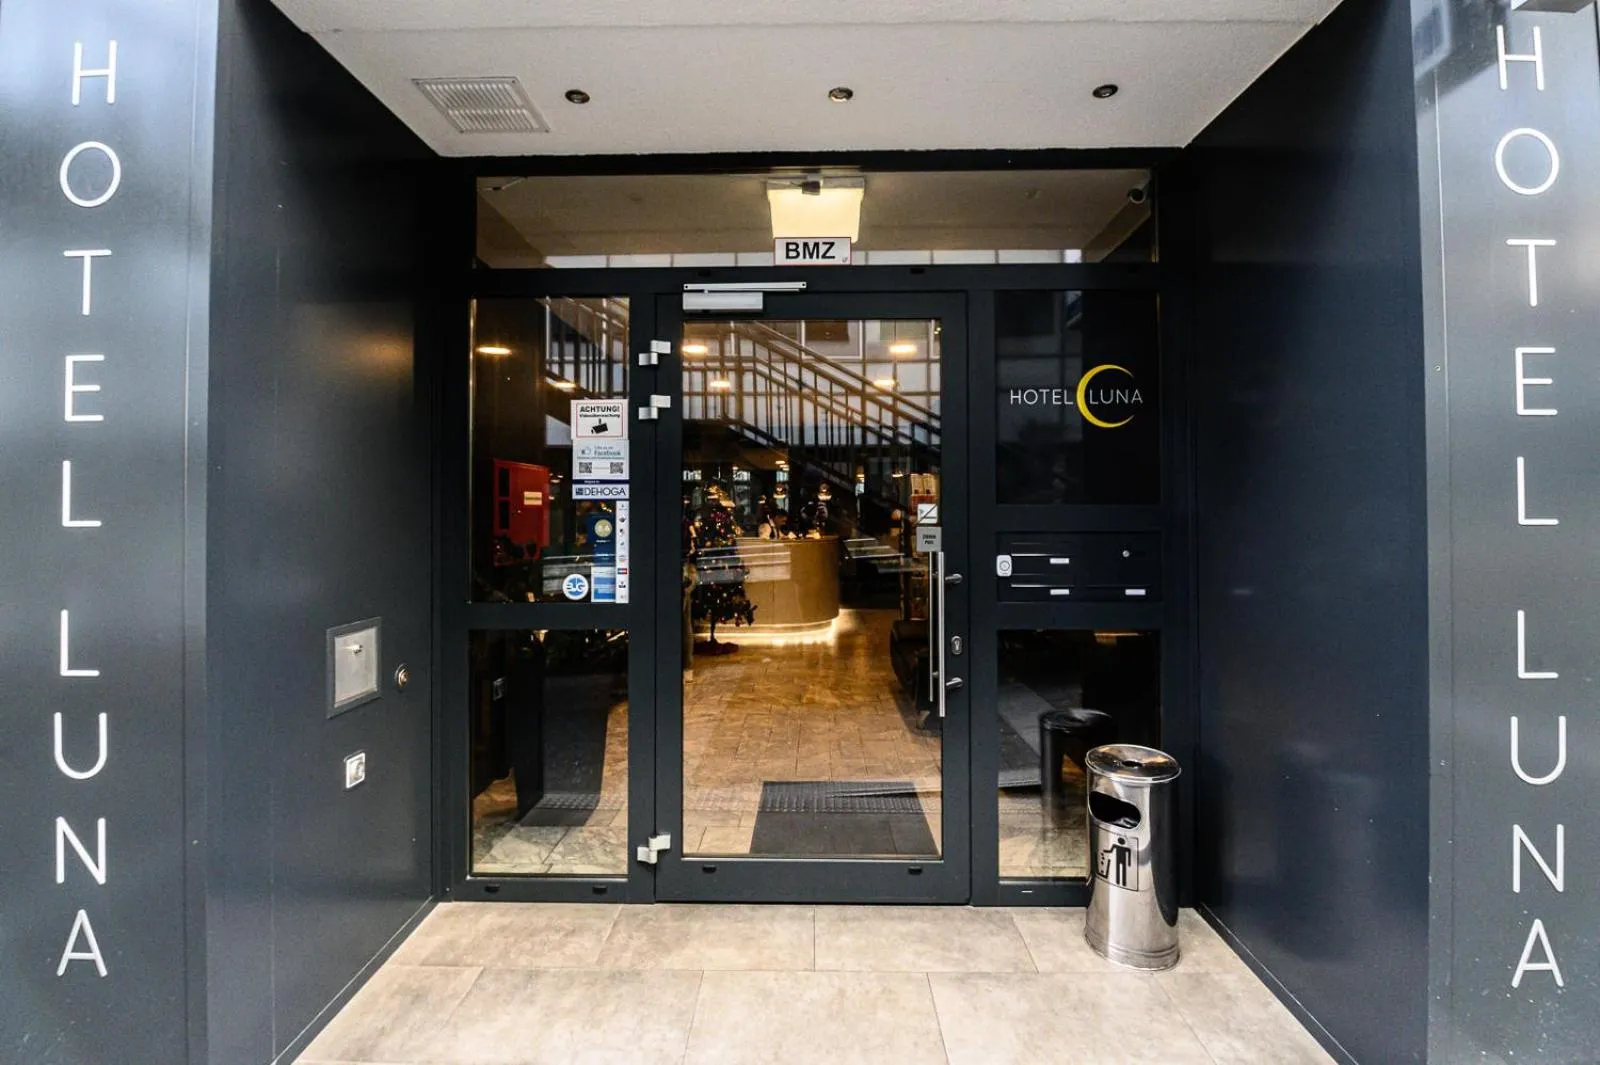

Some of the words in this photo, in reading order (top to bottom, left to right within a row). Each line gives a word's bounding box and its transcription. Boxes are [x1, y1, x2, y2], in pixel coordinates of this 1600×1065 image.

[59, 40, 121, 528] HOTEL
[785, 241, 836, 260] BMZ
[1495, 25, 1560, 526] HOTEL
[580, 405, 620, 413] ACHTUNG!
[584, 487, 626, 496] DEHOGA
[1010, 389, 1074, 405] HOTEL
[1089, 389, 1143, 405] LUNA
[54, 609, 108, 977] LUNA
[1510, 610, 1567, 988] LUNA
